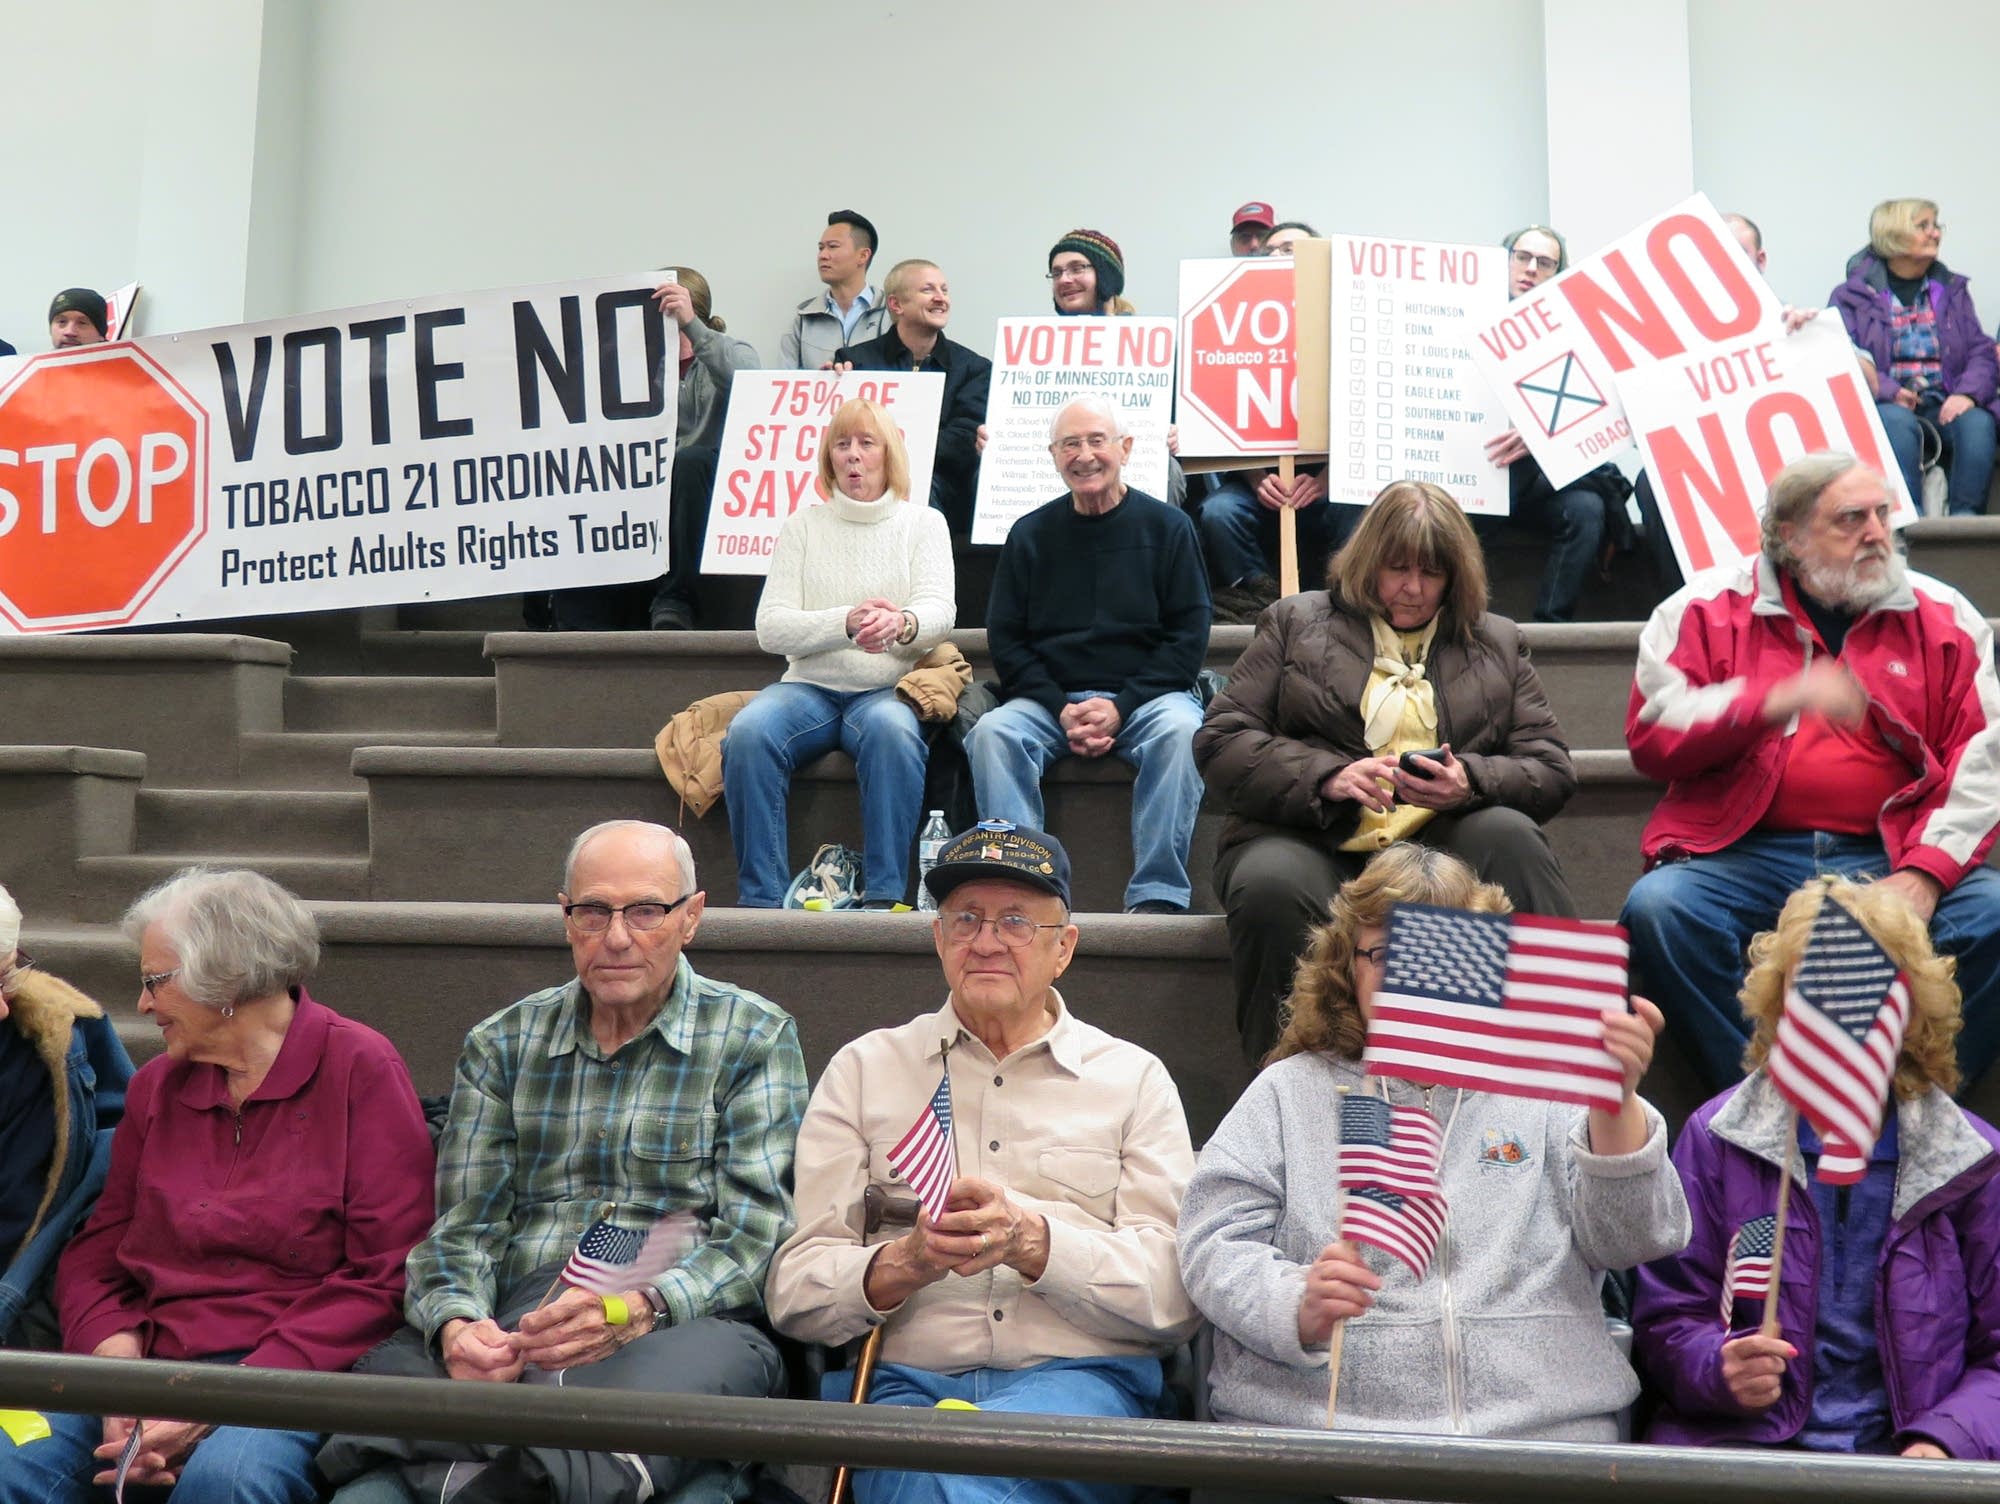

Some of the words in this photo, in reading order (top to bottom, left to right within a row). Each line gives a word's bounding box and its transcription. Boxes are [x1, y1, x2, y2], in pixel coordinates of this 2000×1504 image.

[1348, 241, 1427, 281] VOTE
[1438, 249, 1479, 286] NO
[1352, 280, 1365, 291] NO
[1376, 282, 1393, 294] YES
[1557, 213, 1762, 374] NO
[1405, 303, 1465, 317] HUTCHINSON
[1211, 300, 1296, 346] VO
[1405, 323, 1434, 336] EDINA
[1479, 298, 1562, 361] VOTE
[1003, 325, 1106, 366] VOTE
[1117, 325, 1174, 368] NO
[1195, 349, 1263, 365] Tobacco
[1268, 348, 1288, 364] 21
[1422, 346, 1449, 359] LOUIS
[1452, 347, 1473, 360] PAR
[211, 307, 474, 462] VOTE
[512, 287, 666, 430] NO
[1000, 371, 1031, 386] 71%
[1035, 371, 1052, 386] OF
[1055, 371, 1134, 387] MINNESOTA
[1138, 373, 1168, 387] SAID
[1405, 364, 1422, 377] ELK
[1425, 366, 1454, 379] RIVER
[1685, 342, 1783, 402] VOTE
[769, 380, 844, 416] 75%
[1012, 391, 1031, 405] NO
[1035, 391, 1096, 405] TOBA
[1122, 393, 1152, 407] LAW
[1237, 368, 1297, 429] N
[1405, 385, 1434, 398] EAGLE
[1437, 387, 1462, 401] LAKE
[1405, 406, 1461, 422] SOUTHBEND
[1464, 411, 1487, 424] TWP.
[745, 424, 788, 461] ST
[1405, 427, 1445, 441] PERHAM
[1575, 417, 1630, 459] TOBAC
[1405, 448, 1440, 462] FRAZEE
[222, 467, 390, 529] TOBACCO
[403, 462, 439, 511] 21
[453, 437, 669, 506] ORDINANCE
[1405, 469, 1444, 484] DETROIT
[1447, 473, 1478, 487] LAKES
[222, 546, 337, 587] Protect
[348, 531, 445, 576] Adults
[457, 521, 559, 571] Rights
[568, 511, 663, 556] Today.
[717, 535, 779, 556] TOBAC
[962, 832, 1008, 848] INFANTRY
[1010, 835, 1053, 859] DIVISION
